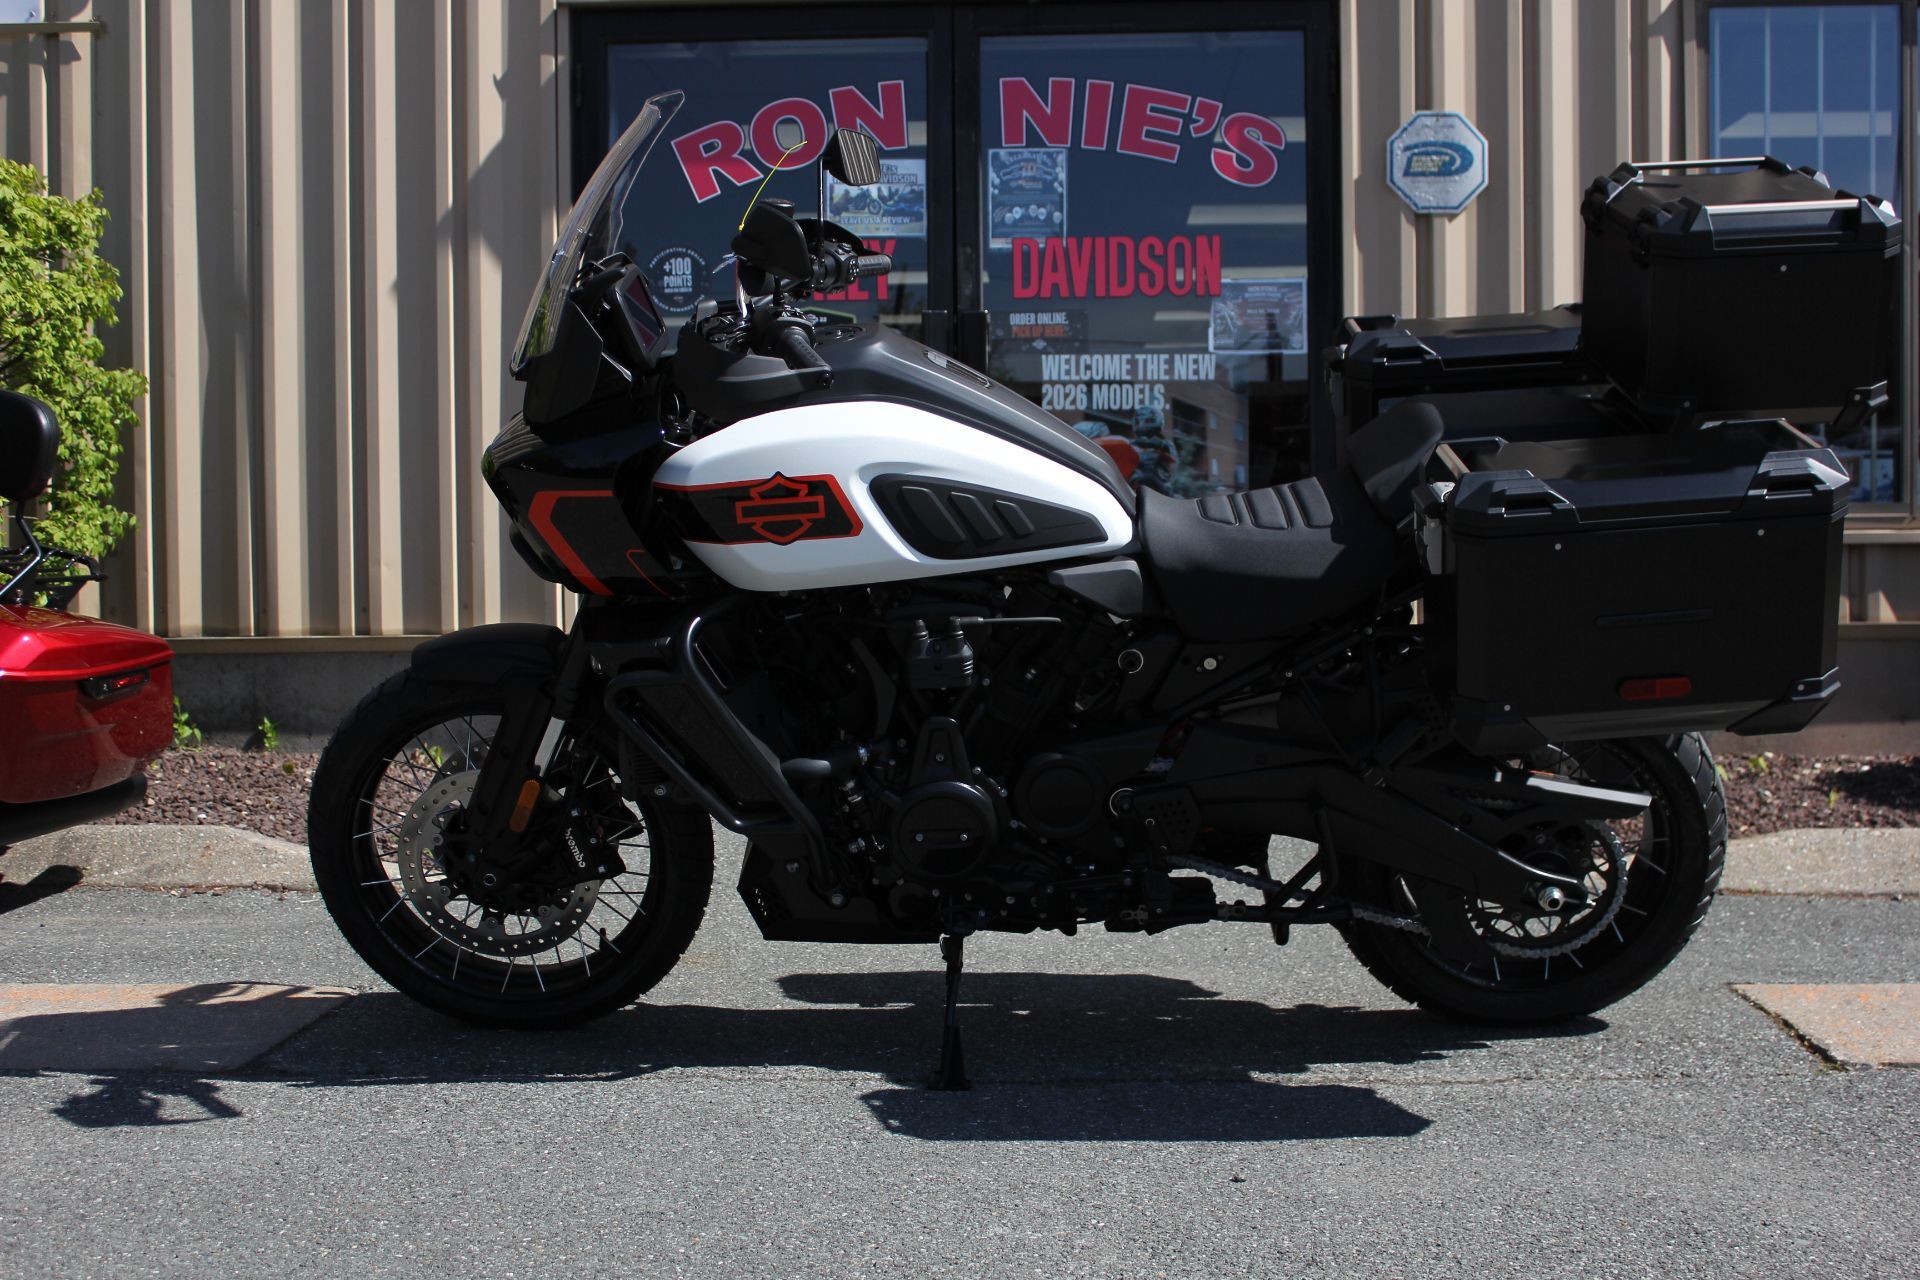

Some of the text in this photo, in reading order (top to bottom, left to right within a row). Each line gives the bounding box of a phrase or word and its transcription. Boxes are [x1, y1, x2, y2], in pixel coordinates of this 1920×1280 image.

[671, 77, 1287, 203] RON NIE'S
[882, 215, 912, 225] REVIEW
[663, 256, 692, 275] +100
[1012, 235, 1222, 298] DAVIDSON
[664, 275, 693, 288] POINTS
[1009, 311, 1069, 325] ORDER ONLINE.
[1041, 354, 1216, 381] WELCOME THE NEW
[1042, 383, 1170, 411] 2026 MODELS.
[565, 827, 586, 868] brembo
